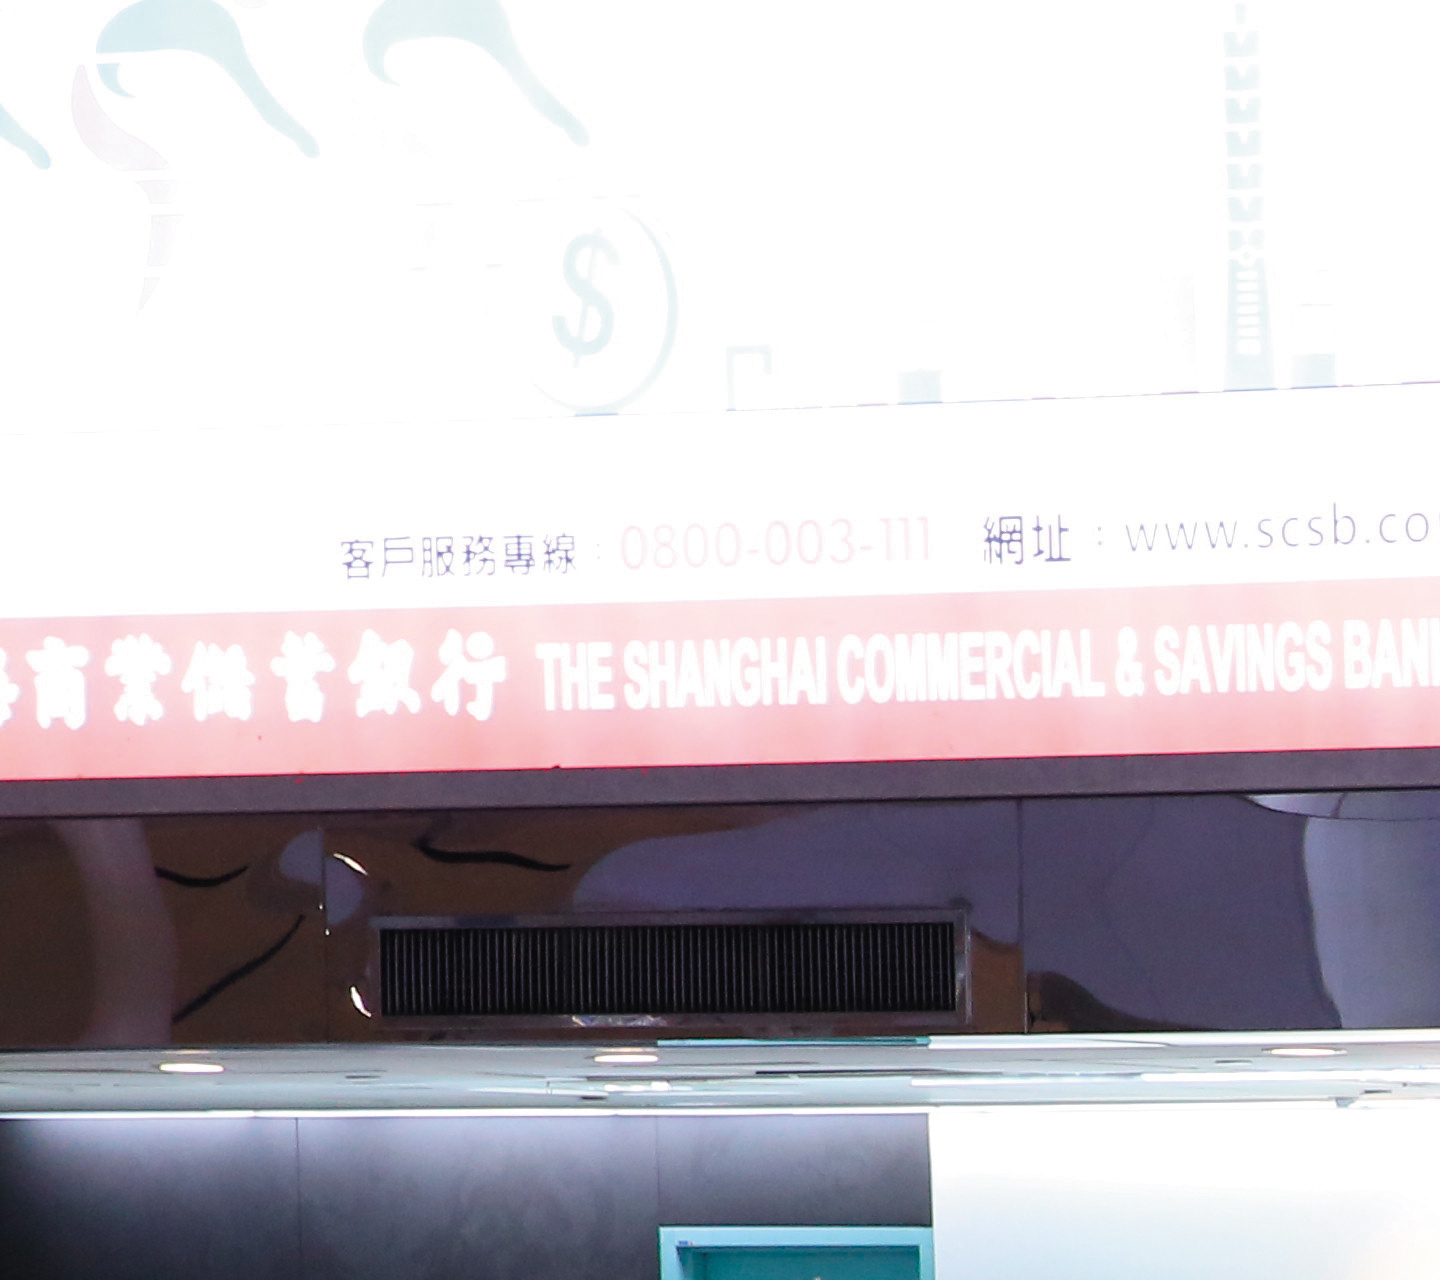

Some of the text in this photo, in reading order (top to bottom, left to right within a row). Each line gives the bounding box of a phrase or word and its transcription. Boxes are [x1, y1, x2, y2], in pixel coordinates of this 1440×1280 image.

[619, 515, 932, 571] 0800-003-111
[535, 641, 614, 711] THE
[623, 635, 827, 709] SHANGHAI
[837, 629, 1106, 704] COMMERCIAL
[1114, 625, 1145, 697] &
[1153, 620, 1333, 696] SAVINGS
